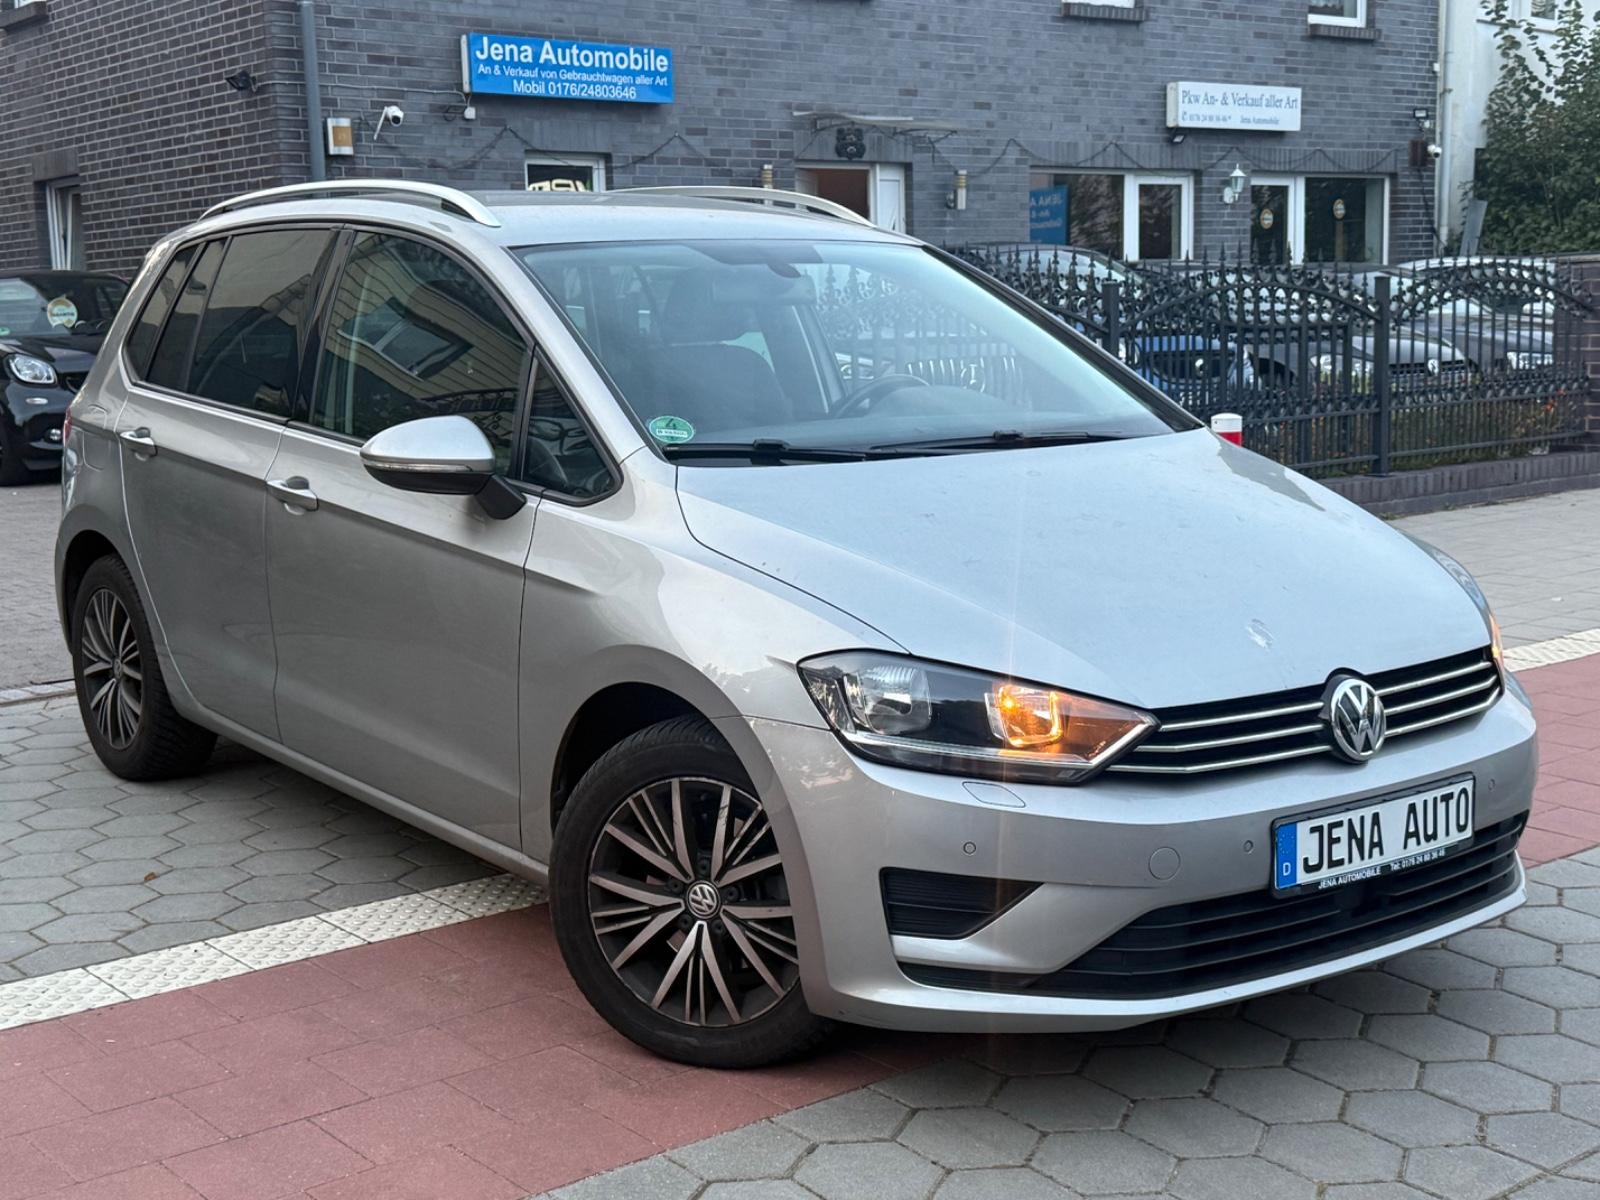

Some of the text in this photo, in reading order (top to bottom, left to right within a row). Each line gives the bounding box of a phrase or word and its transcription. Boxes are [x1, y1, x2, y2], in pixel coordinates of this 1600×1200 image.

[475, 36, 669, 72] Jena Automobile
[477, 64, 668, 86] An & Verkauf von Gebrauchtwagen aller Art
[513, 79, 637, 100] Mobil 0176/24803646
[1181, 90, 1298, 109] Pkw An- & Verkauf aller Art
[1303, 787, 1470, 874] JENA AUTO
[1282, 862, 1291, 877] D
[1318, 866, 1382, 890] JENA AUTOMOBILE
